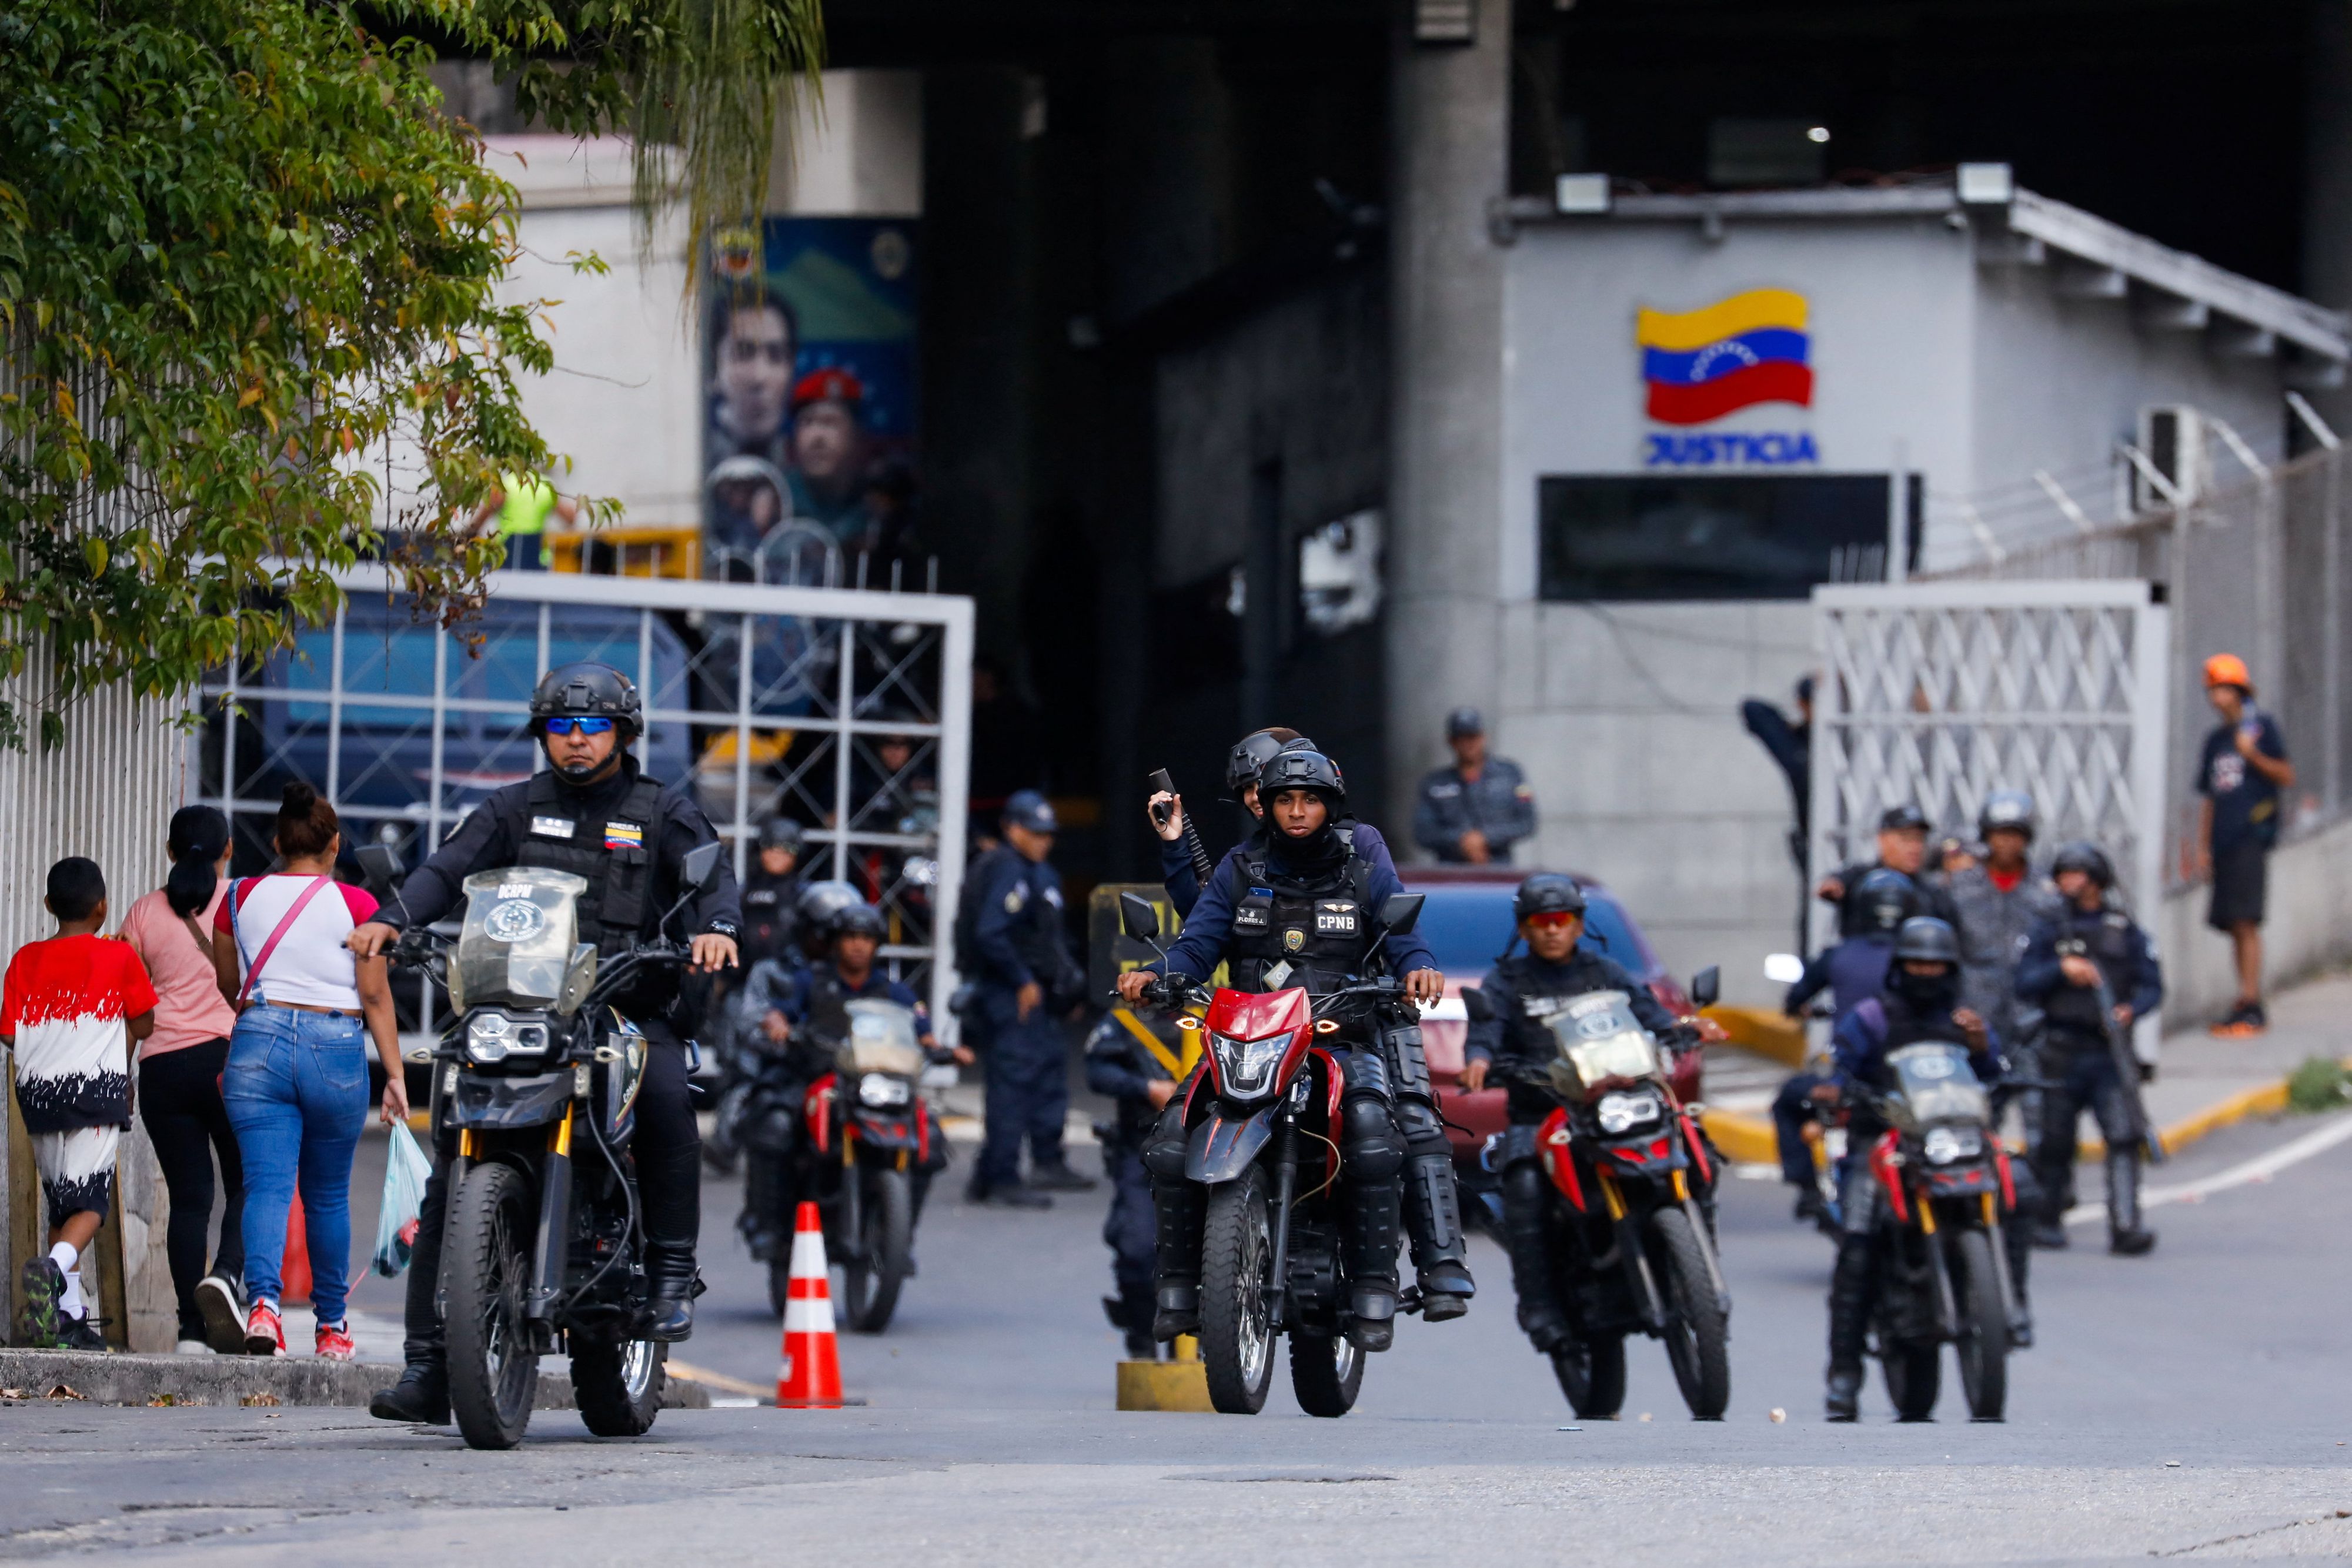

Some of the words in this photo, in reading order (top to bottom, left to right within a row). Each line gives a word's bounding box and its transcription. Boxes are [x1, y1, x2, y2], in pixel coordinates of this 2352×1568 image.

[1646, 433, 1818, 464] JUSTICIA
[606, 821, 642, 833] VENEZUELA
[1317, 916, 1355, 930] CPNB
